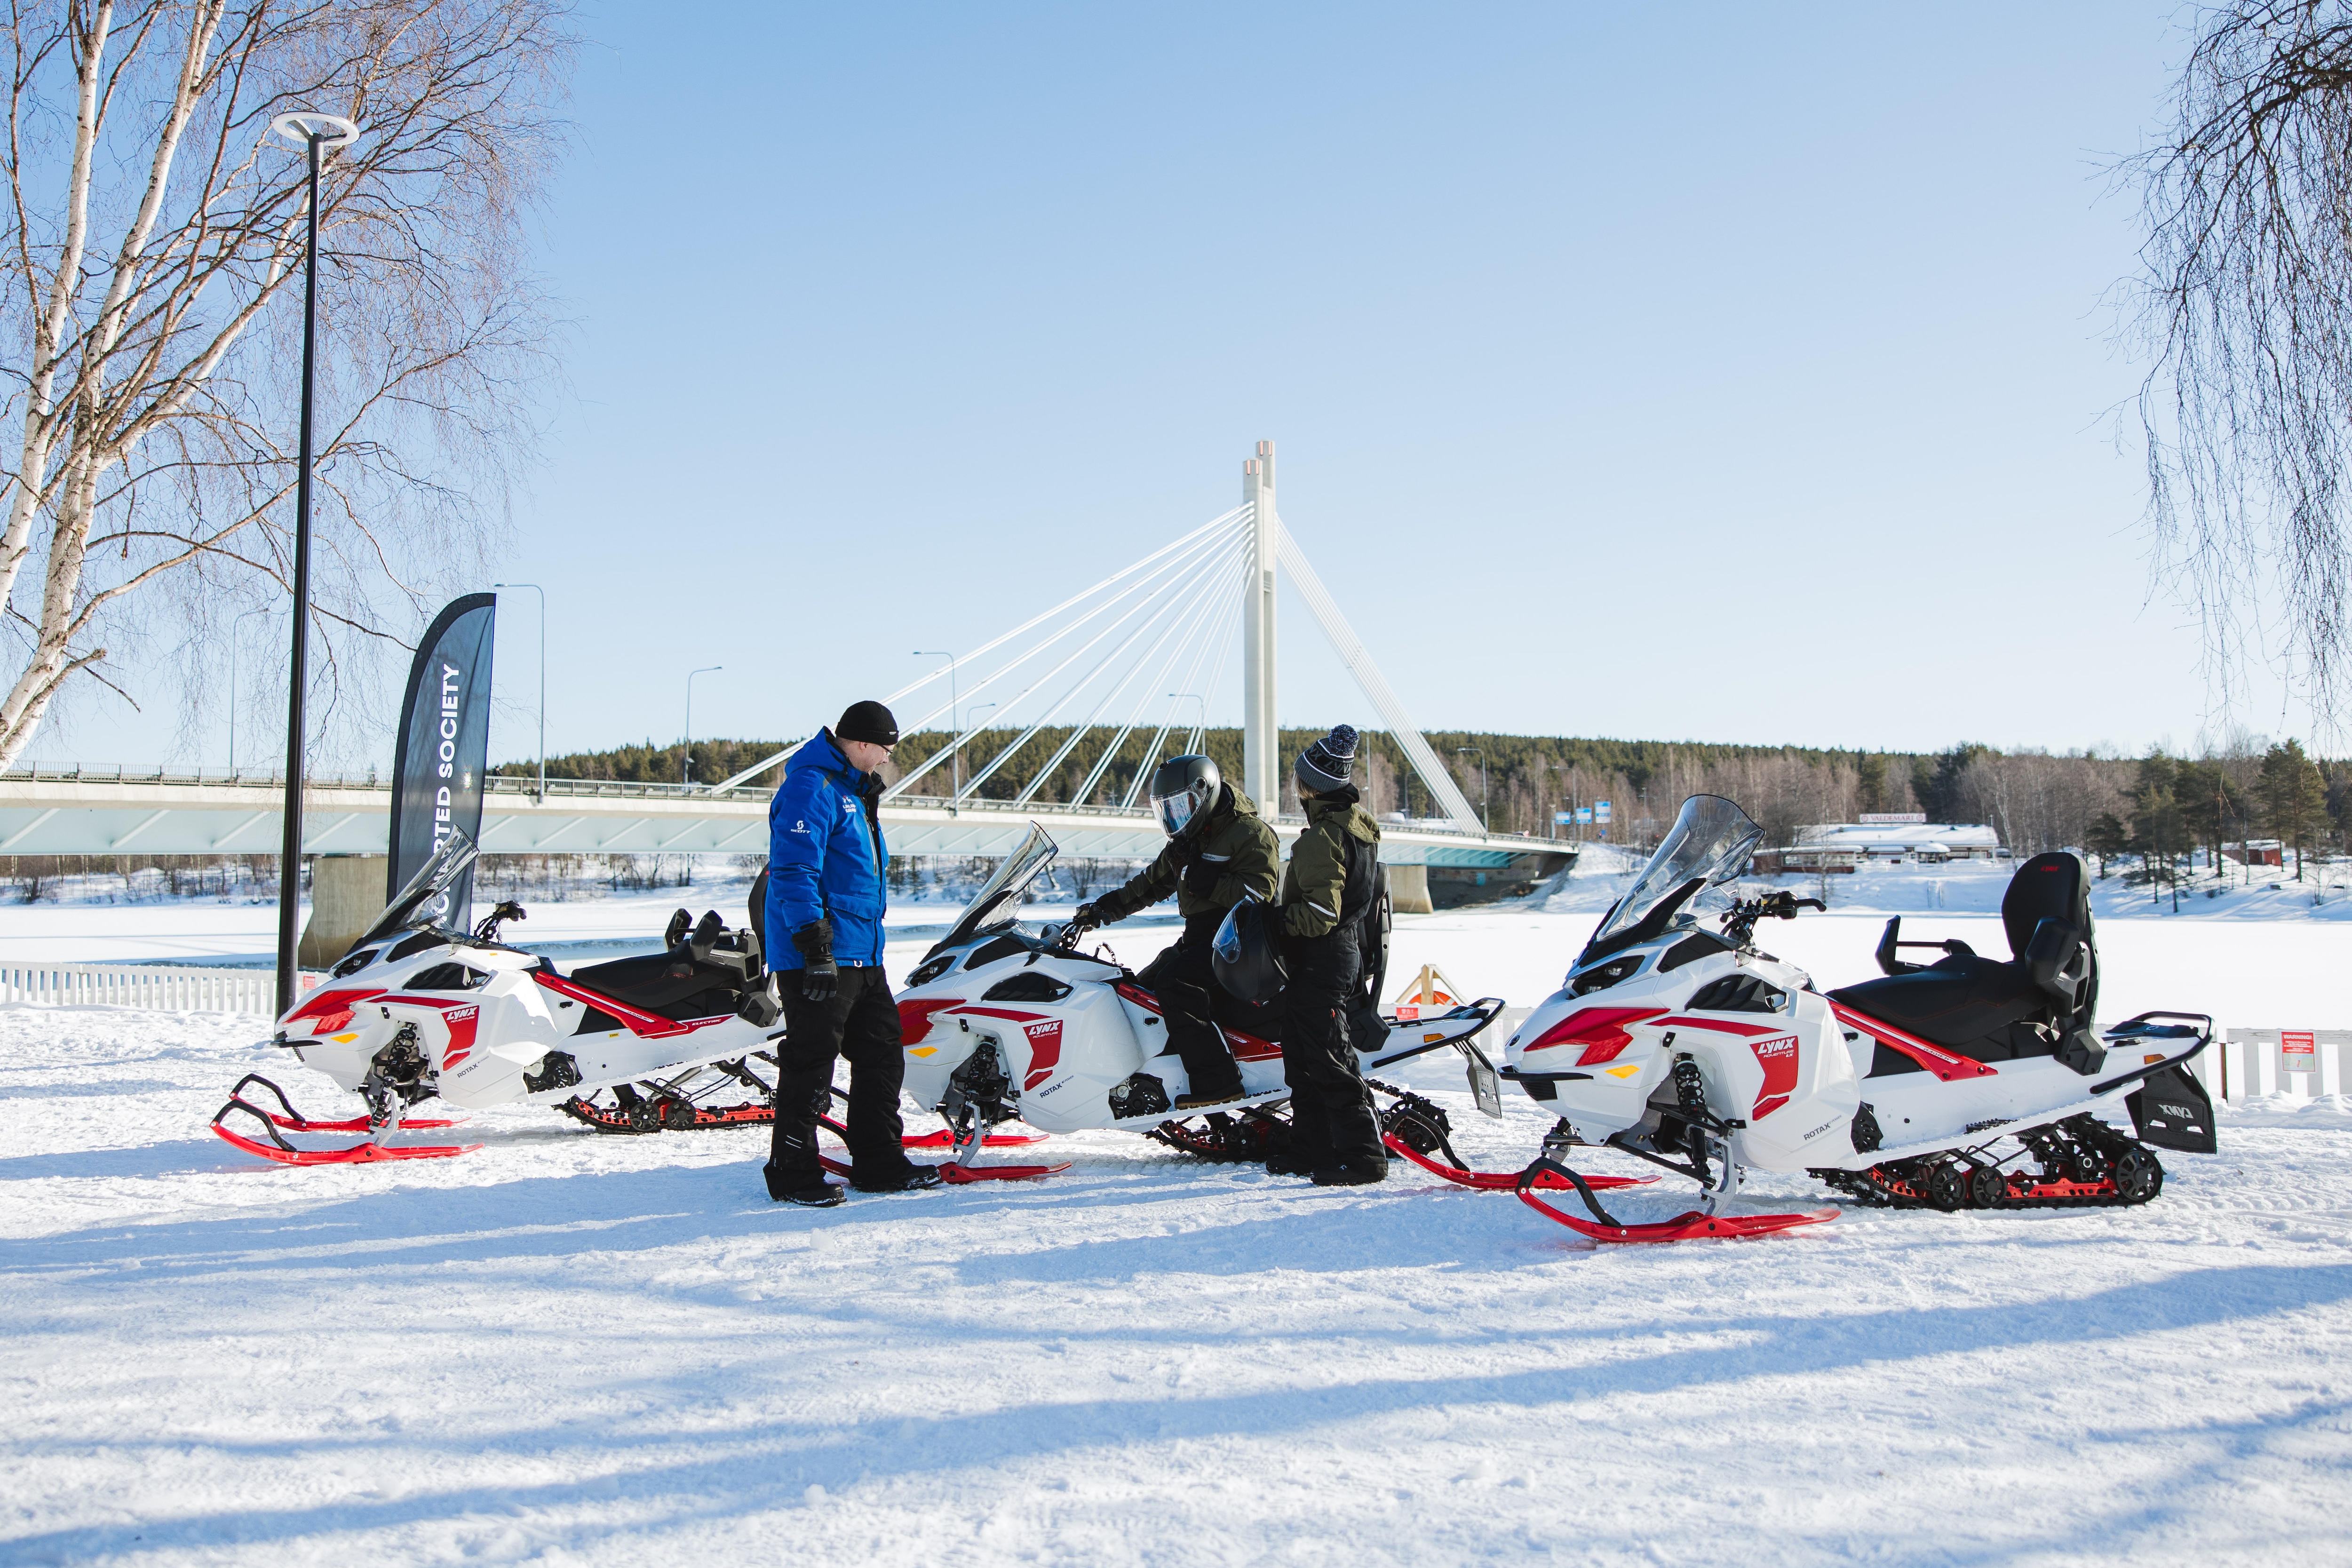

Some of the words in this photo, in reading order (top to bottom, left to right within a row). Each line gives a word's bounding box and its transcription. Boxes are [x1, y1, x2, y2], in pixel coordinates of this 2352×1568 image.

[438, 664, 460, 779] SOCIETY
[446, 1007, 477, 1020] LYNX
[1028, 1021, 1061, 1035] LYNX
[1757, 1037, 1796, 1054] LYNX
[1763, 1050, 1795, 1058] ADVENTURE
[457, 1063, 478, 1078] ROTAX
[1040, 1082, 1063, 1098] ROTAX
[1803, 1122, 1831, 1140] ROTAX
